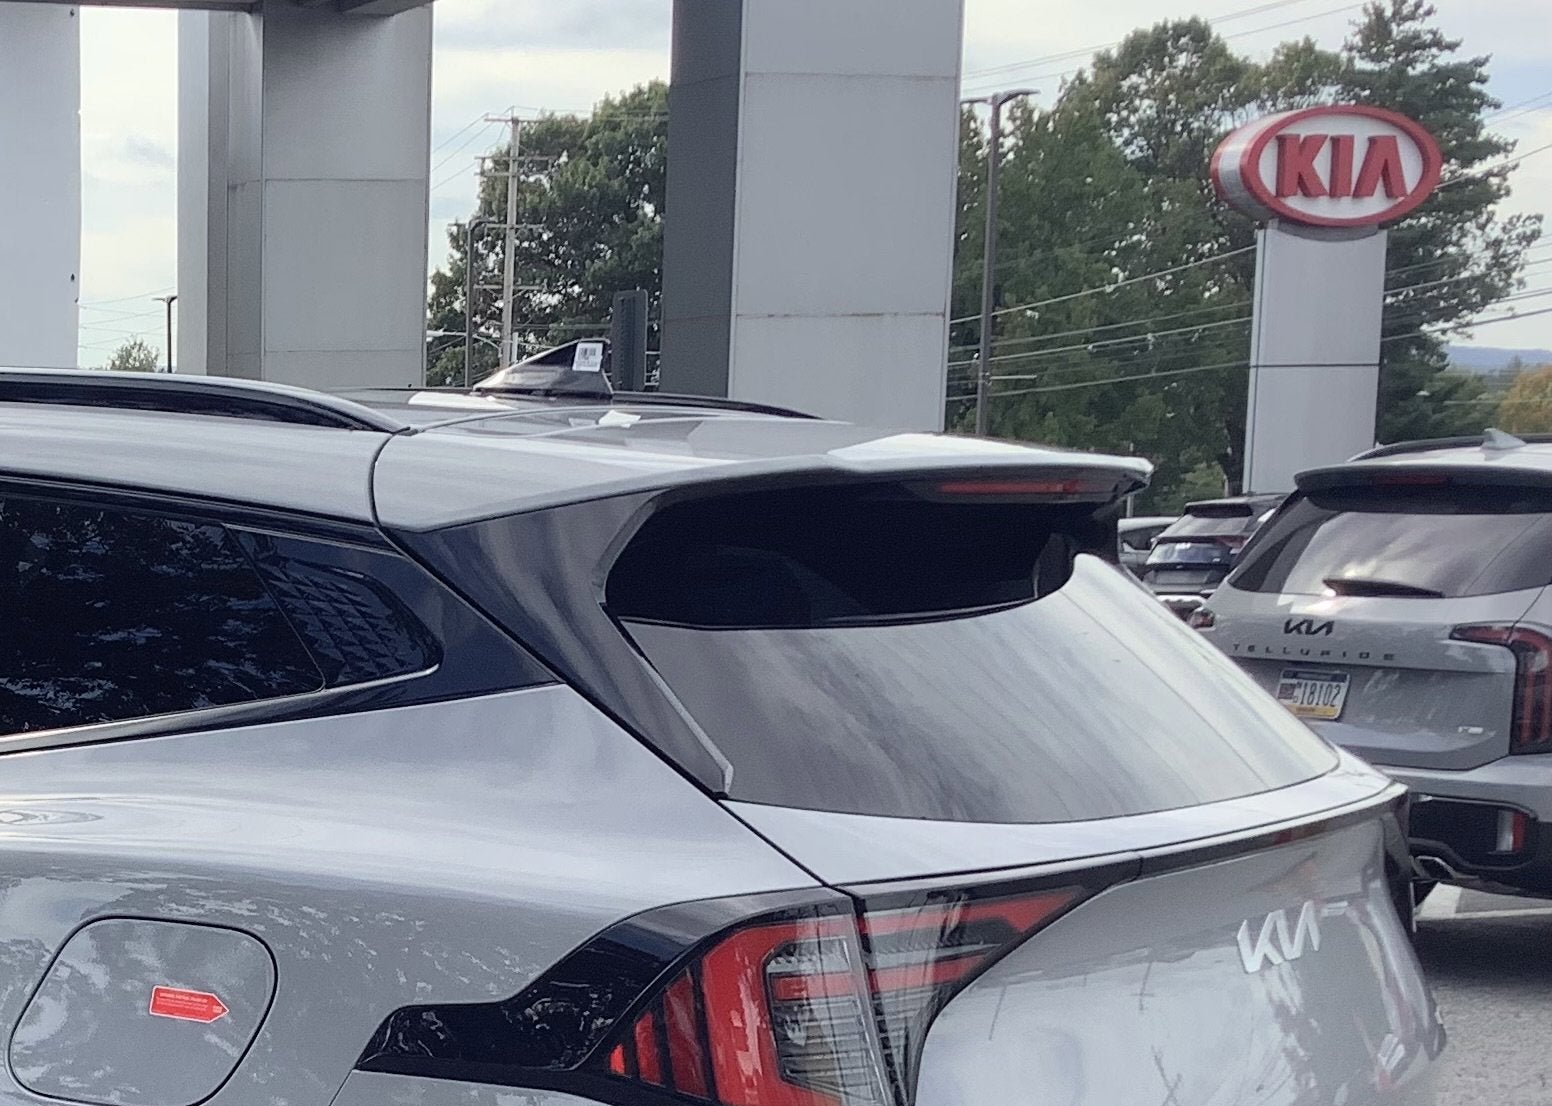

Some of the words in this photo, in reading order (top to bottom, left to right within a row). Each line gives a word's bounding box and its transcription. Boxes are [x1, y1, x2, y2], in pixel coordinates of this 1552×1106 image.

[1275, 134, 1409, 199] KIA
[1283, 618, 1334, 637] KIA
[1232, 643, 1397, 661] TELLURIDE
[1236, 899, 1321, 974] KIA
